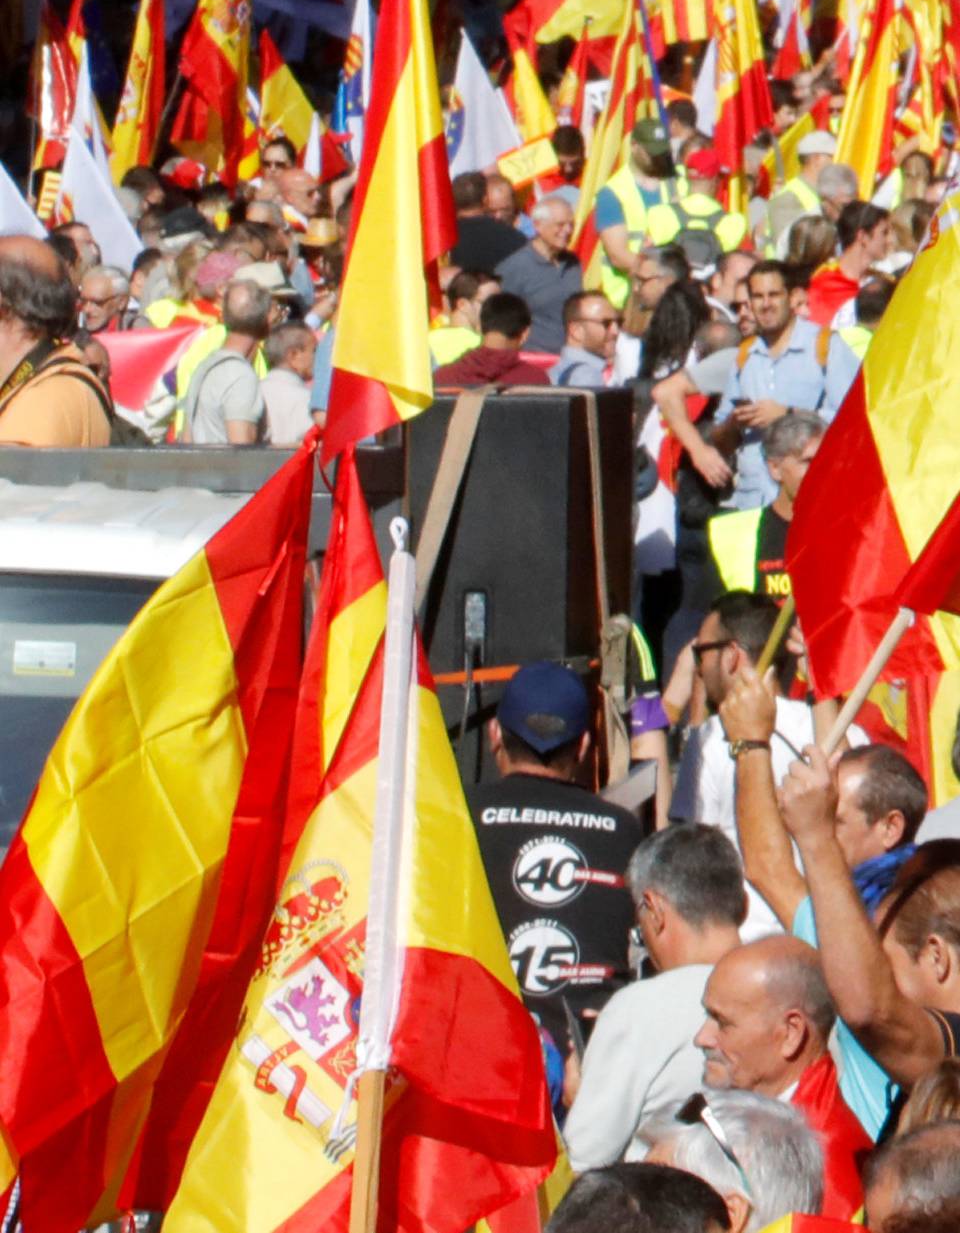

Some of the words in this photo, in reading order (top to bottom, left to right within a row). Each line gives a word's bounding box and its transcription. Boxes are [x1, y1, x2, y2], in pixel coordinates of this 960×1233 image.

[766, 574, 791, 596] NO
[481, 808, 616, 831] CELEBRATING
[516, 856, 583, 891] 40
[511, 945, 576, 989] 15
